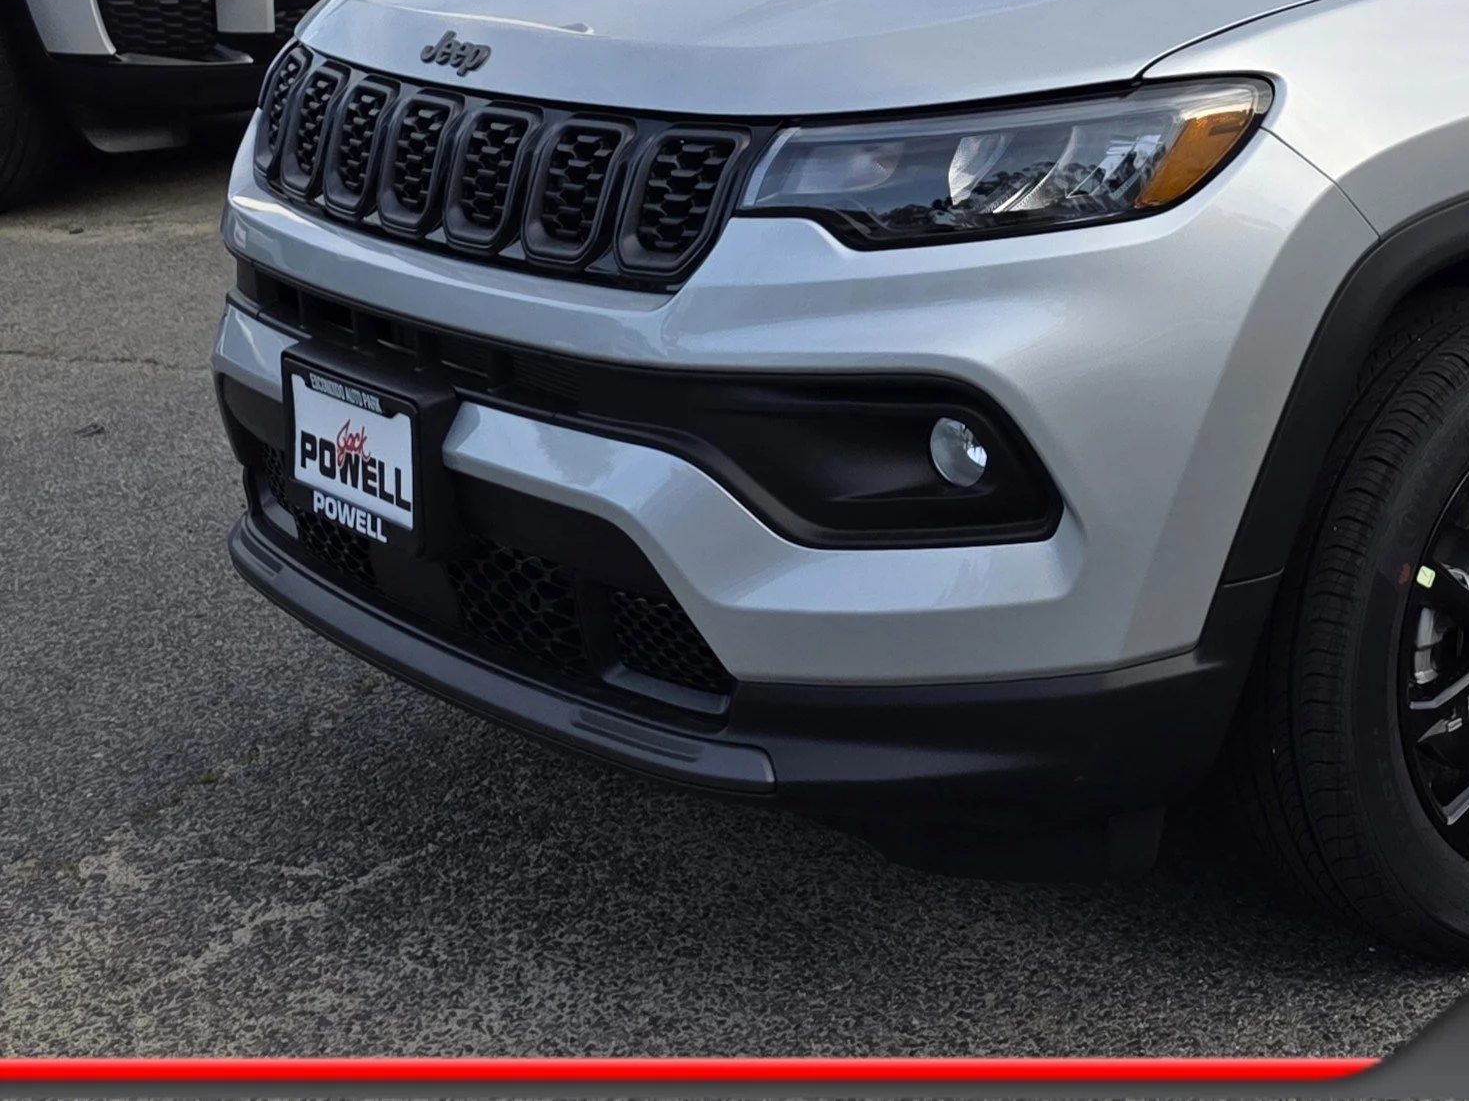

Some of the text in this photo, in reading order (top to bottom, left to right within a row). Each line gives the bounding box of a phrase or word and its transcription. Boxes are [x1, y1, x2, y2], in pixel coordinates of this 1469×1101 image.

[420, 30, 492, 78] Jeep
[336, 418, 371, 469] Jack
[300, 430, 412, 512] POWELL
[312, 489, 388, 544] POWELL
